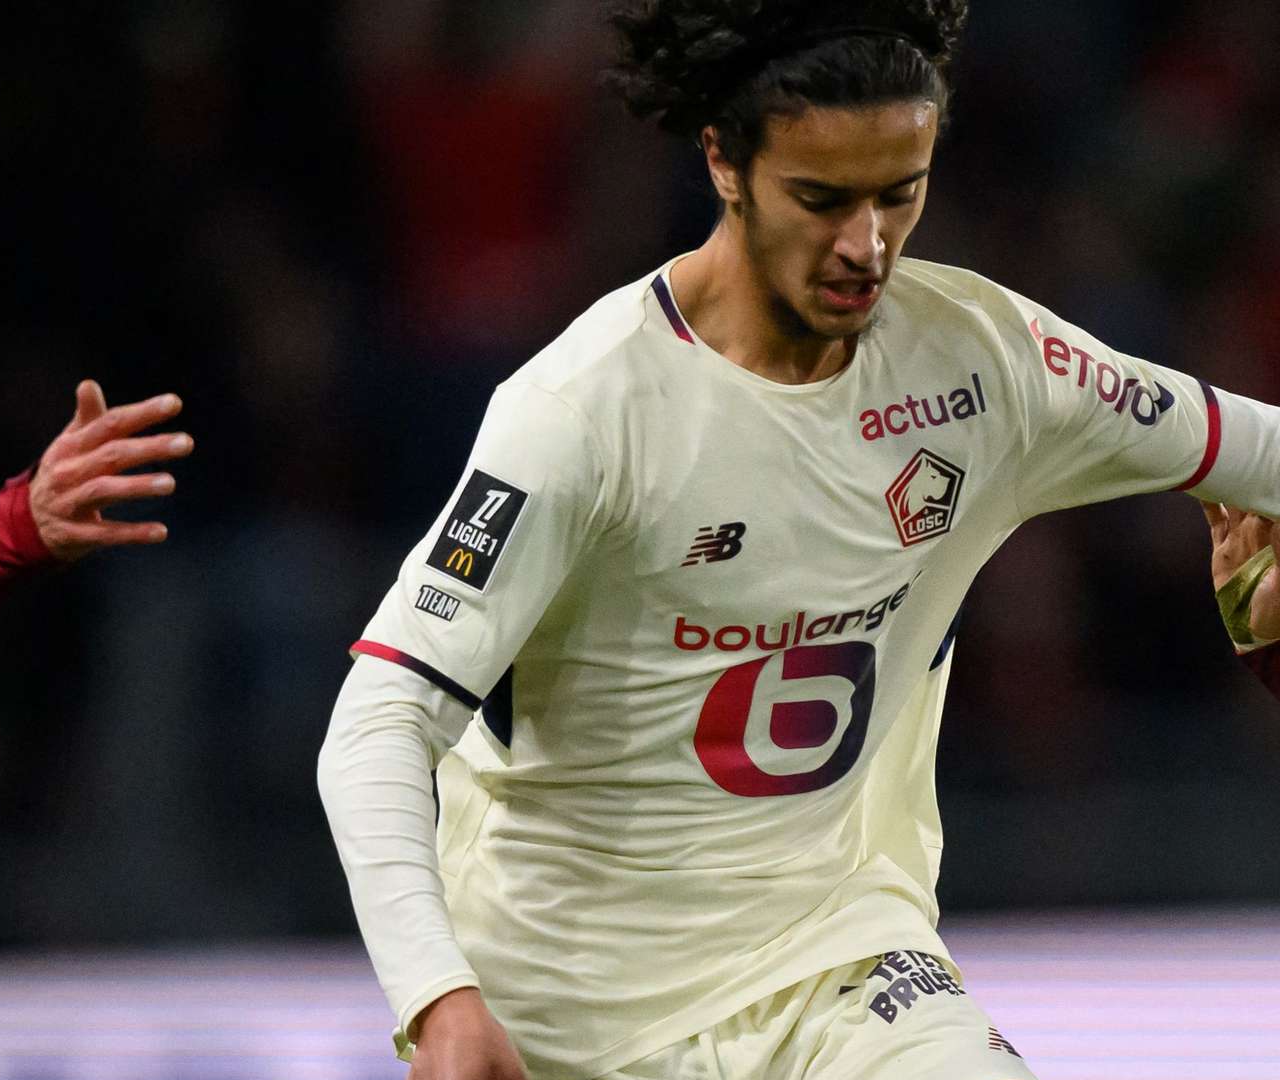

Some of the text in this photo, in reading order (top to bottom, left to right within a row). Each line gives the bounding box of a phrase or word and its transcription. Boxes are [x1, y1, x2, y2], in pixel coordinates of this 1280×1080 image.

[859, 373, 986, 441] actual
[447, 518, 491, 553] LIGUE
[908, 511, 945, 537] LOSC
[673, 577, 912, 651] boulange
